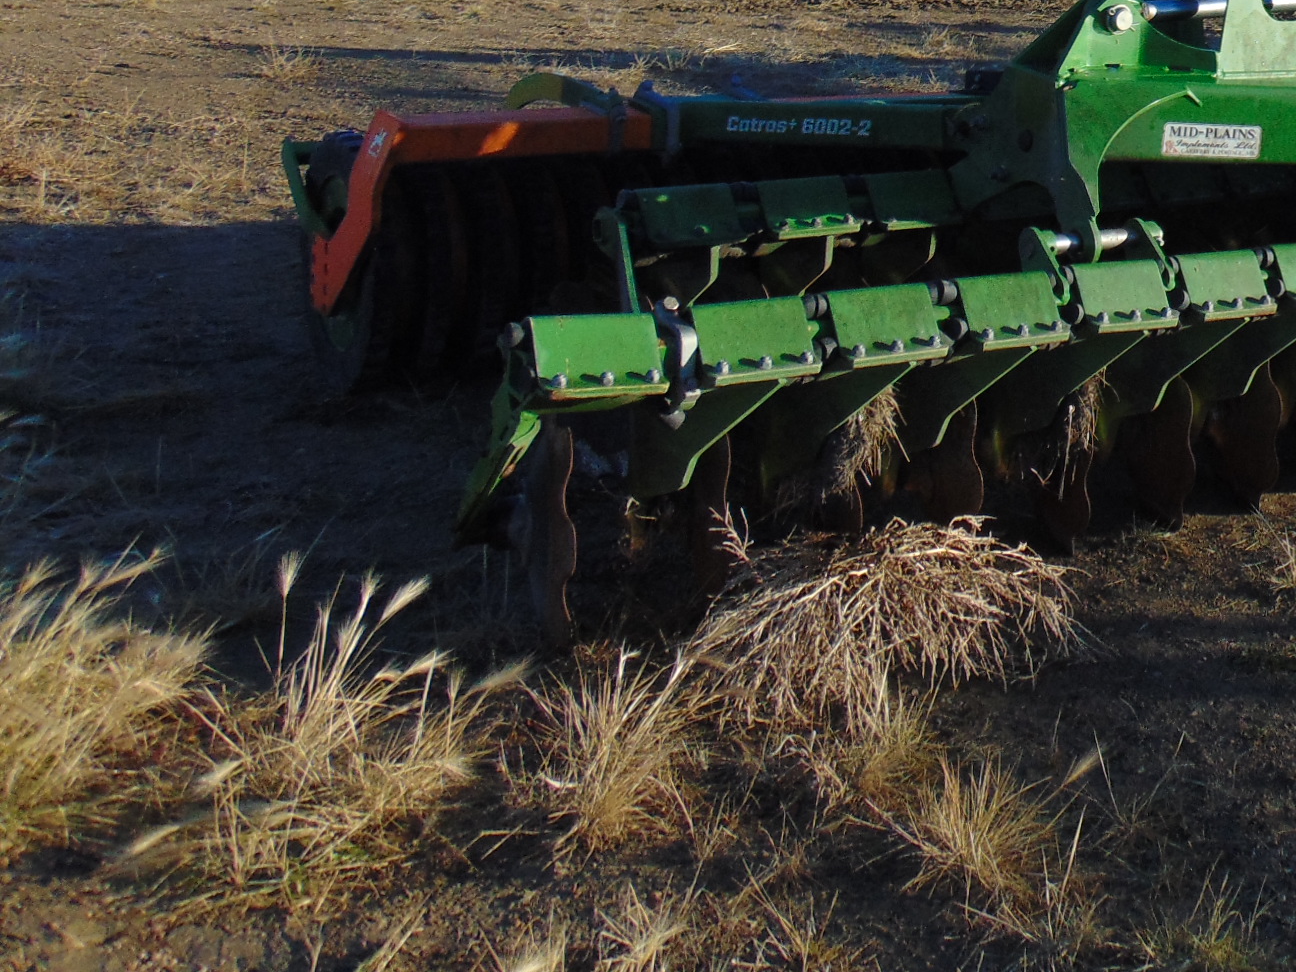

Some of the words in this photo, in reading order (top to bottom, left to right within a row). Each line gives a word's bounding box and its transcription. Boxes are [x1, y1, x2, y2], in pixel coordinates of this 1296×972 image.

[802, 118, 872, 136] 6002-2
[1169, 126, 1256, 139] MID-PLAINS
[1176, 140, 1229, 149] Implements
[1234, 141, 1257, 149] Ltd.
